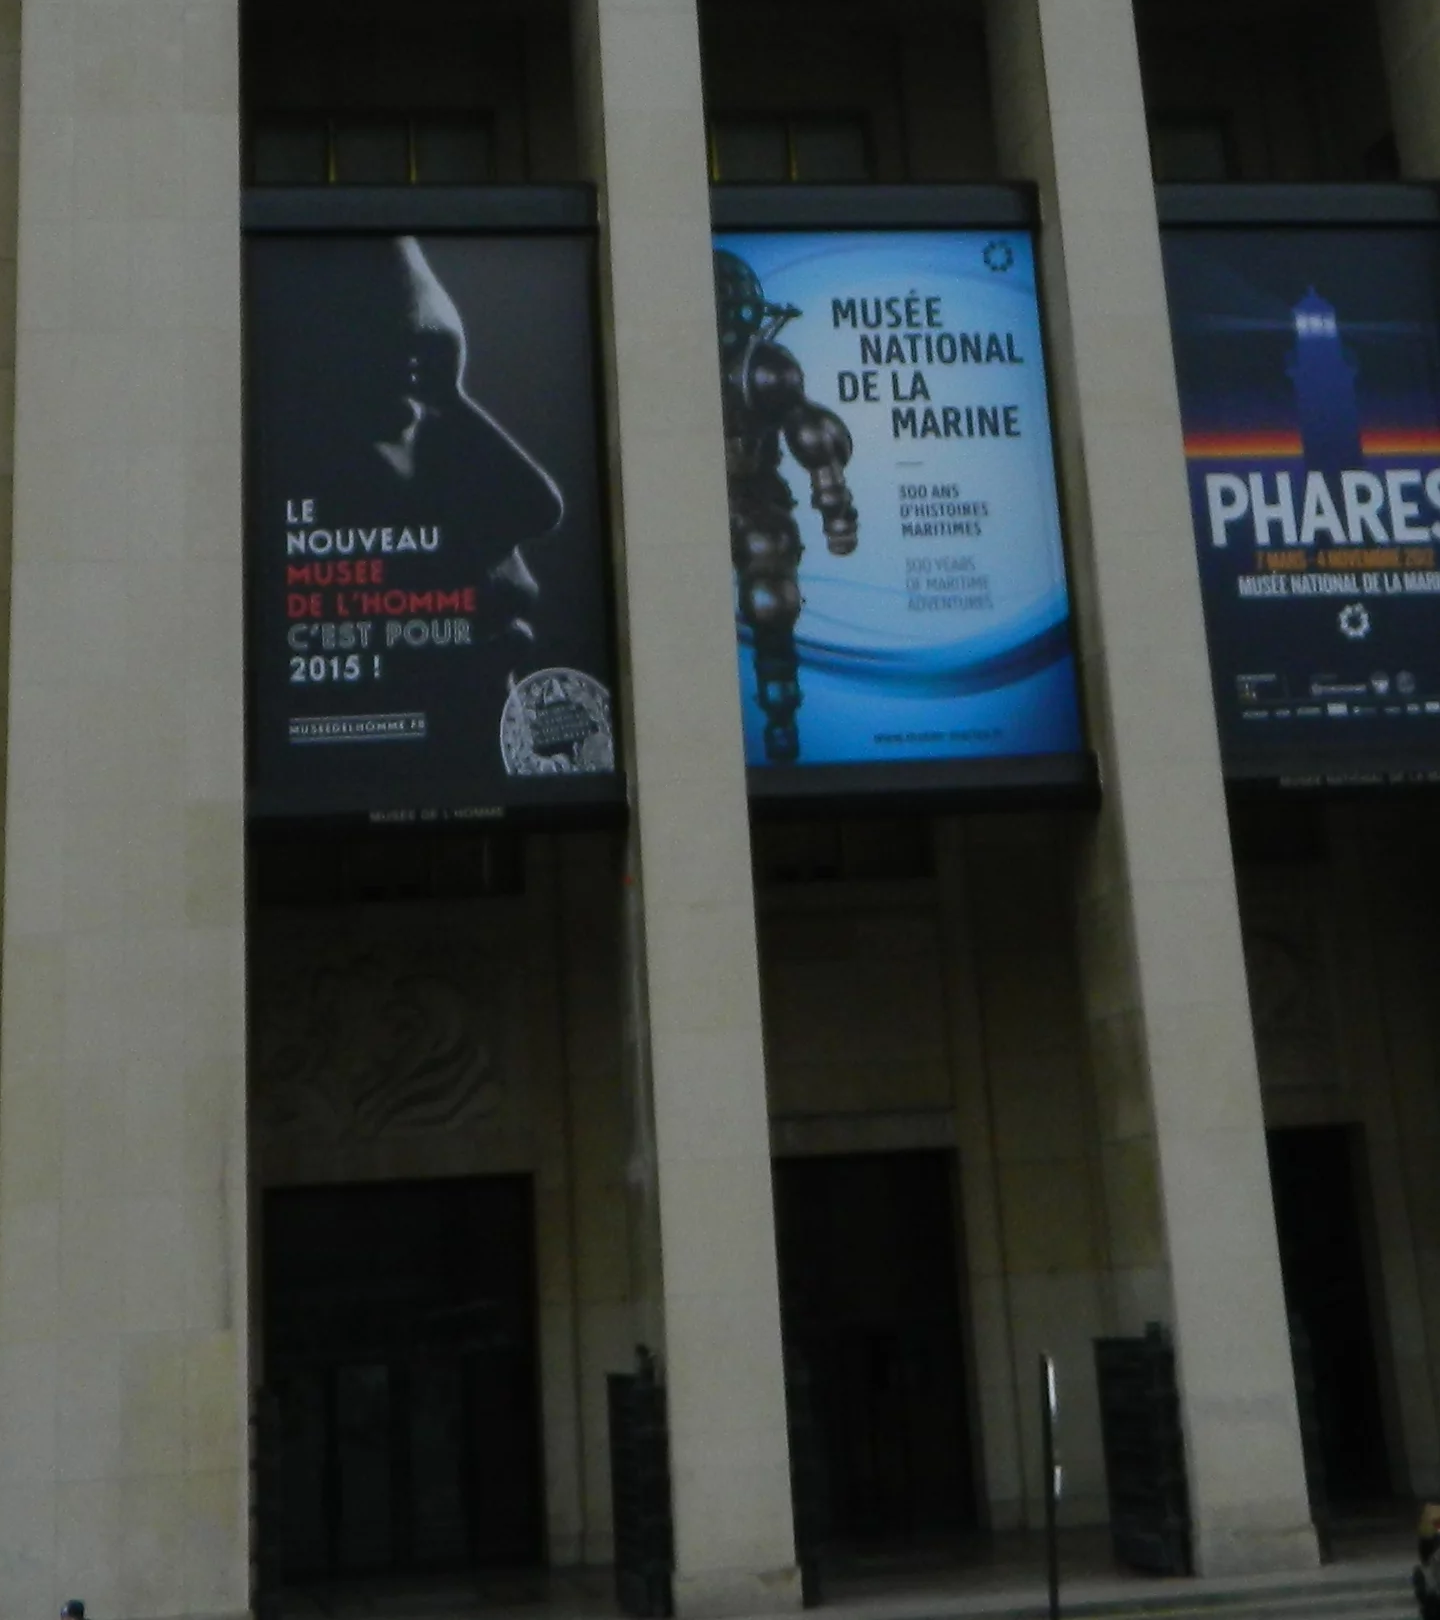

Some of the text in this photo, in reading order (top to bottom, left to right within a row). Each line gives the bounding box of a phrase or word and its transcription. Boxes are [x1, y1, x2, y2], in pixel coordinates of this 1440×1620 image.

[831, 288, 943, 329] MUSÉE
[859, 332, 1024, 364] NATIONAL
[837, 369, 931, 402] DE LA
[891, 405, 1021, 439] MARINE
[931, 483, 960, 499] ANS
[287, 498, 315, 524] LE
[900, 501, 988, 519] D'HISTOIRES
[286, 525, 440, 556] NOUVEAU
[901, 520, 982, 538] MARITIMES
[1238, 570, 1287, 596] MUSÉE
[1290, 572, 1360, 595] NATIONAL
[1362, 572, 1382, 593] DE
[1384, 571, 1402, 593] LA
[287, 586, 476, 619] DE L'HOMME
[287, 617, 472, 650] C'EST POUR
[289, 653, 361, 683] 2015
